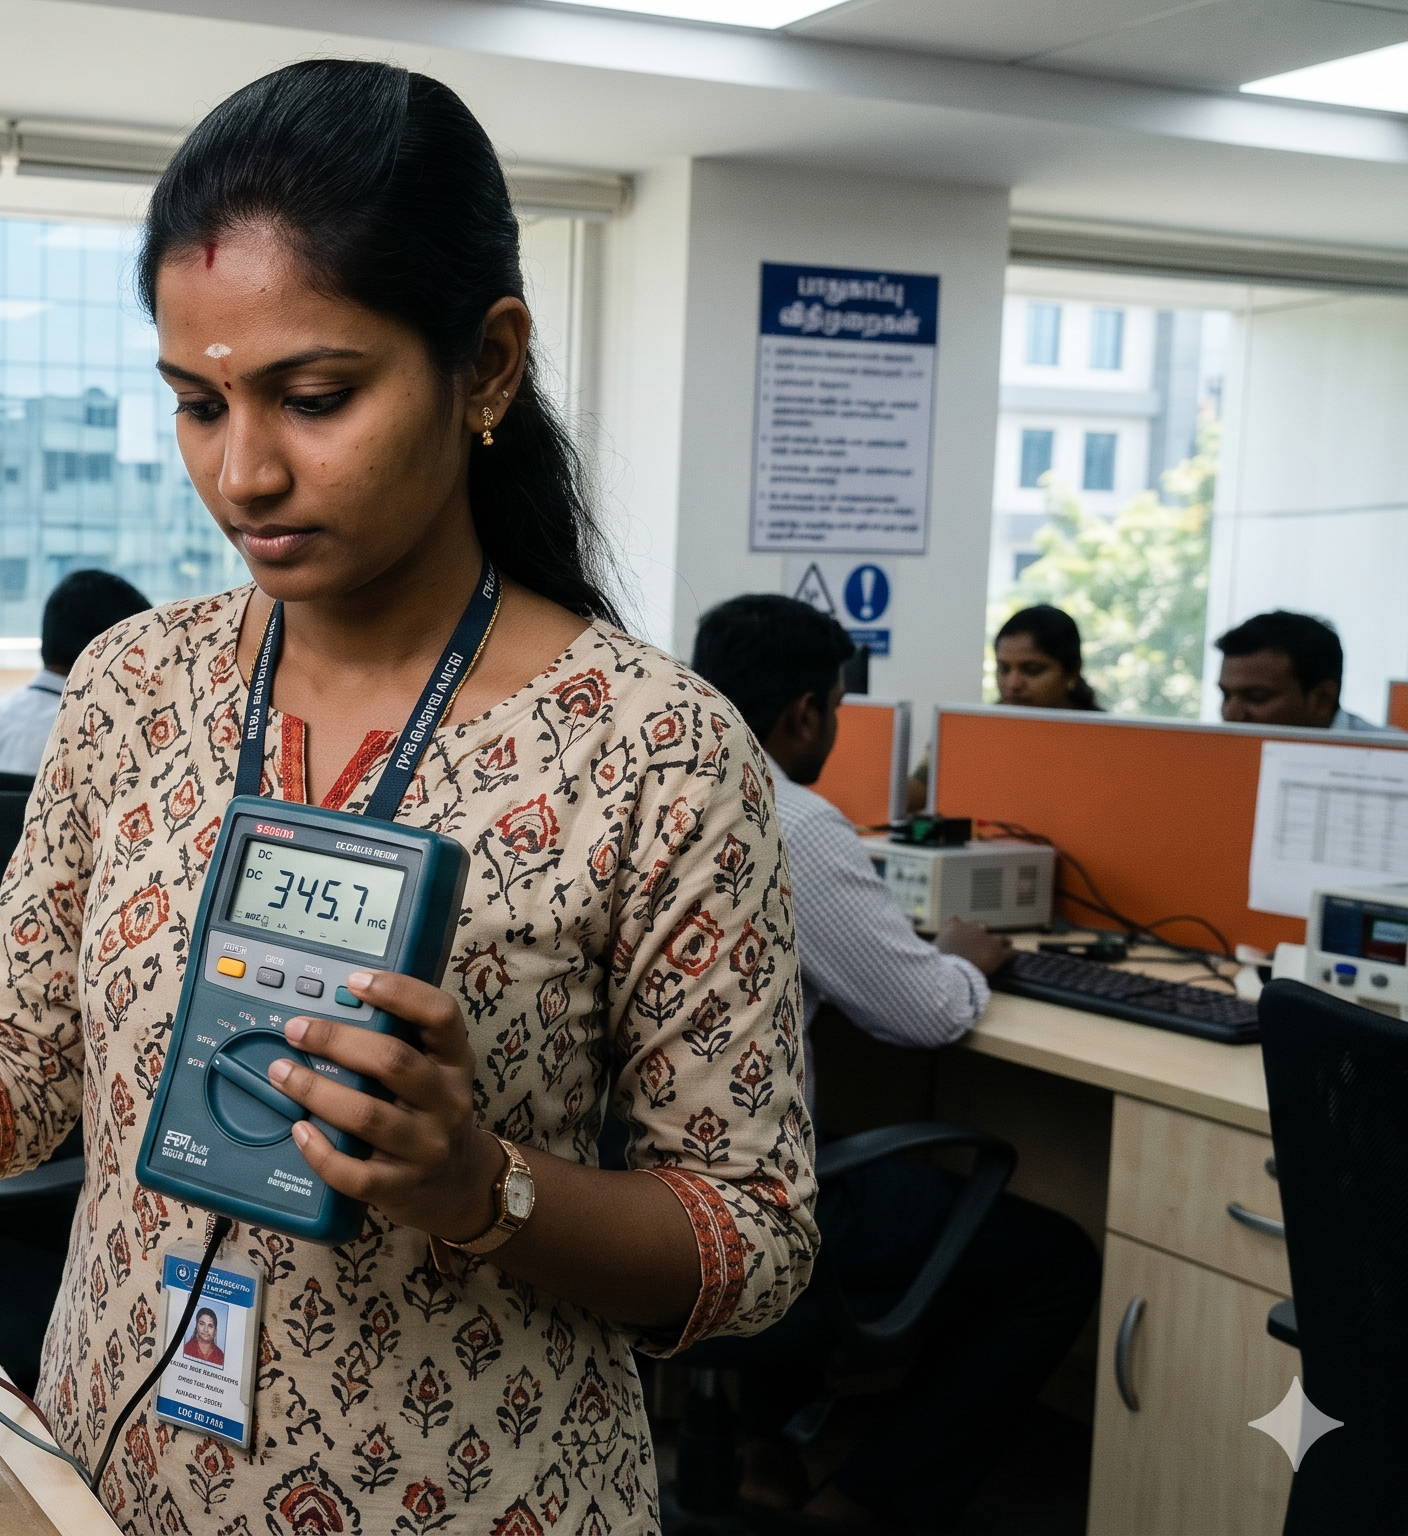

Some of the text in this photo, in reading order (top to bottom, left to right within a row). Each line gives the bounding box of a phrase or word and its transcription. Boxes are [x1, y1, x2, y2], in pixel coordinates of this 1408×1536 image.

[797, 275, 905, 309] பாதுகாப்பு
[258, 849, 273, 861] DC
[246, 868, 263, 881] DC
[267, 869, 369, 925] 345.7
[367, 918, 387, 930] mG
